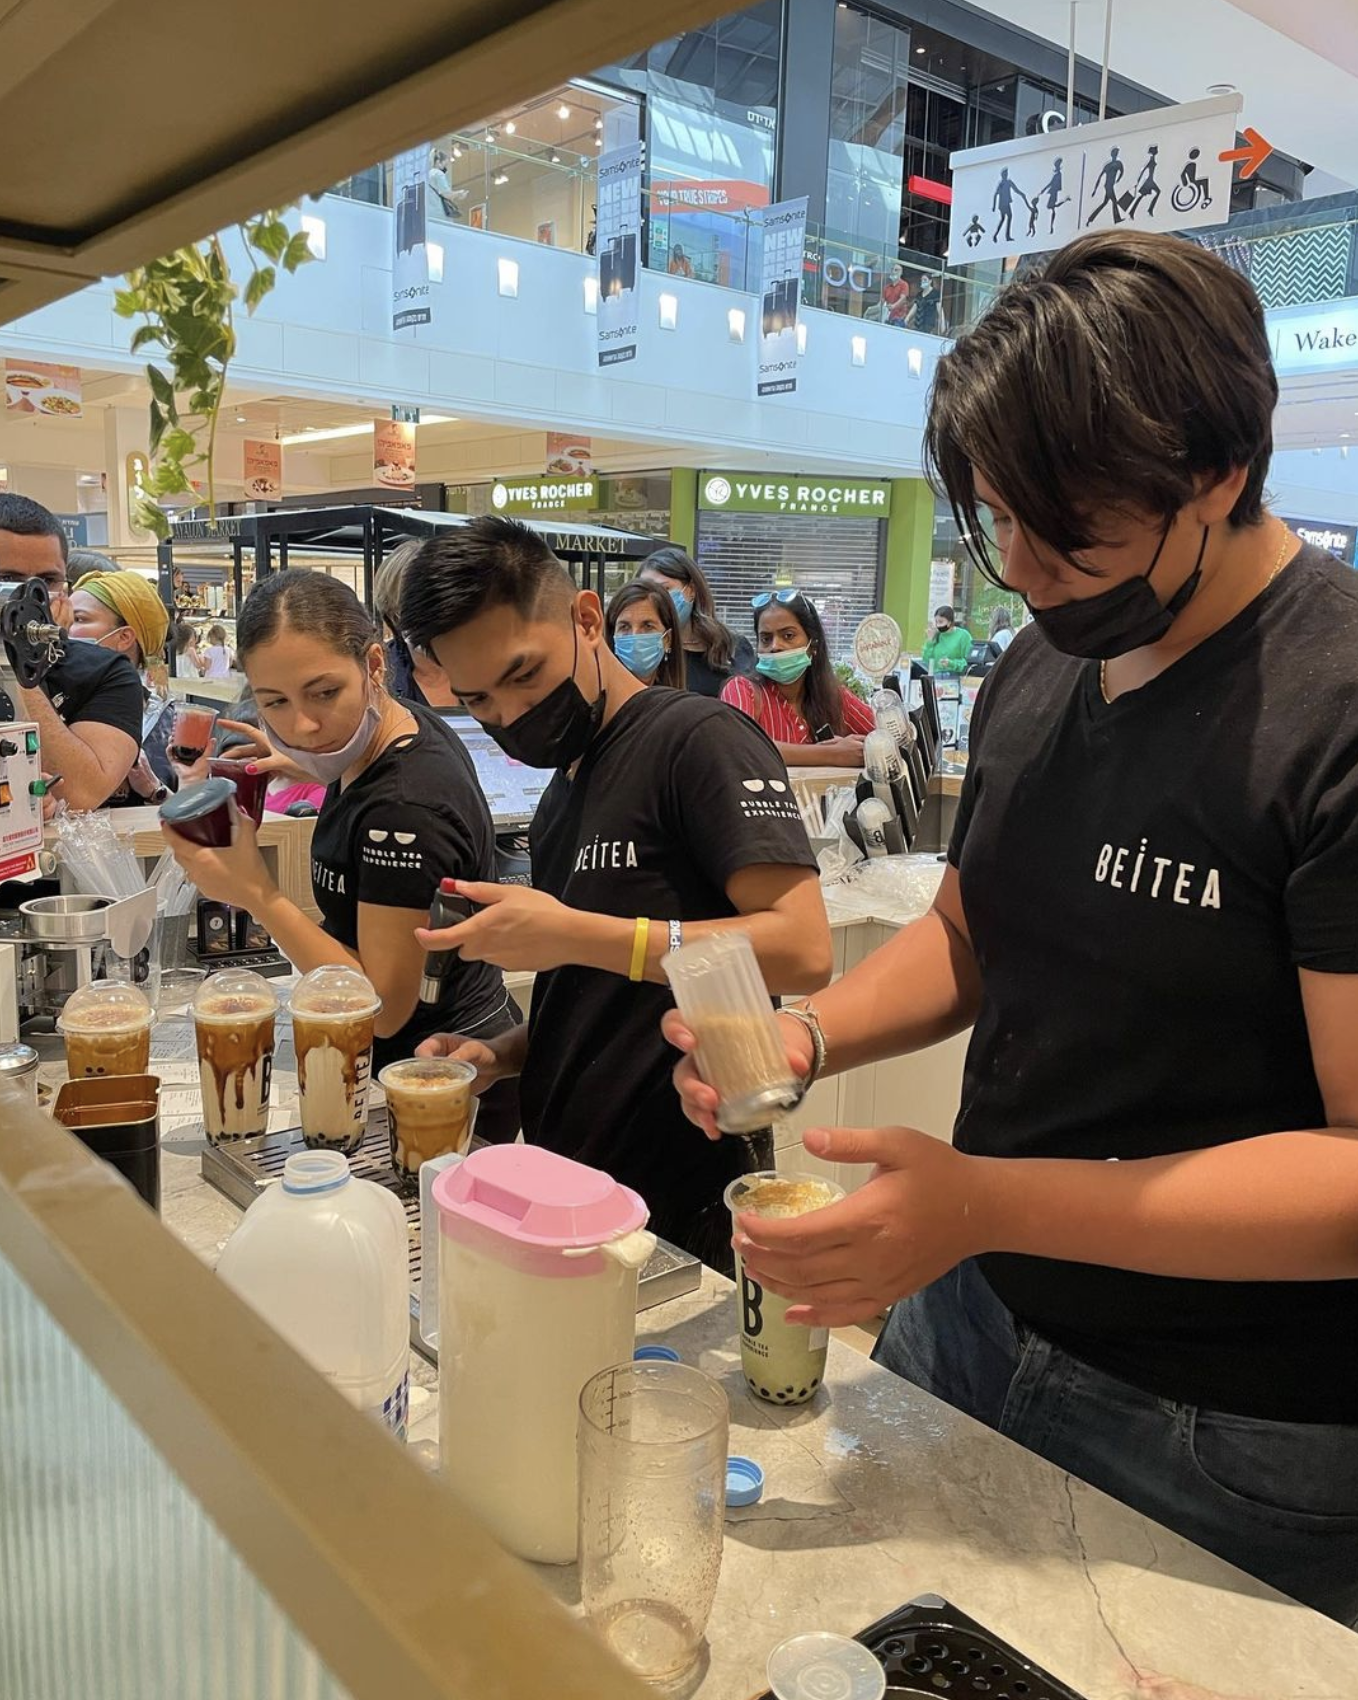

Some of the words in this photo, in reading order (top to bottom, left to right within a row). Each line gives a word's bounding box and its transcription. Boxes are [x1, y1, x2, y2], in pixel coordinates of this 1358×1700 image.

[763, 210, 805, 227] Samsonite
[763, 227, 803, 253] NEW
[1294, 327, 1357, 352] Wake
[508, 486, 538, 501] YVES
[540, 482, 593, 500] ROCHER
[736, 484, 789, 501] YVES
[797, 486, 885, 505] ROCHER
[531, 500, 565, 508] FRANCE
[780, 503, 838, 513] FRANCE
[555, 533, 628, 554] MARKET
[401, 851, 422, 860] TEA
